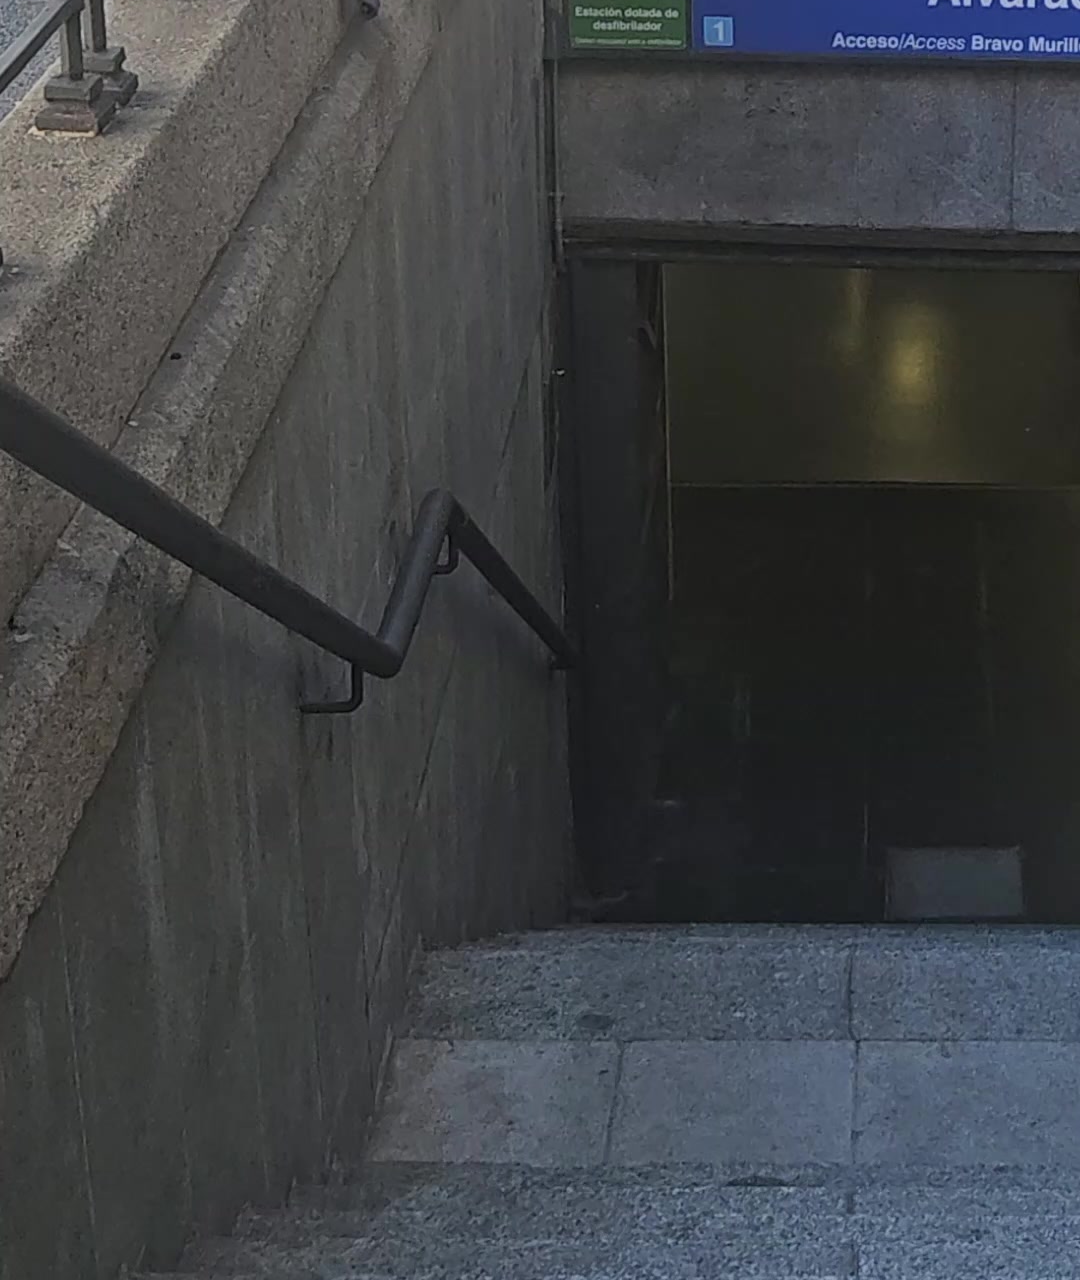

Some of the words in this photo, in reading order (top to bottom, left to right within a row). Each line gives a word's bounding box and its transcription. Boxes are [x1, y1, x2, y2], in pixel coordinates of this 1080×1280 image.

[575, 5, 623, 18] Estación
[624, 7, 662, 18] dotada
[664, 8, 680, 18] de
[592, 20, 662, 31] desfibrilador
[713, 21, 725, 42] 1
[831, 31, 967, 51] Acceso/Access
[971, 35, 1024, 52] Bravo
